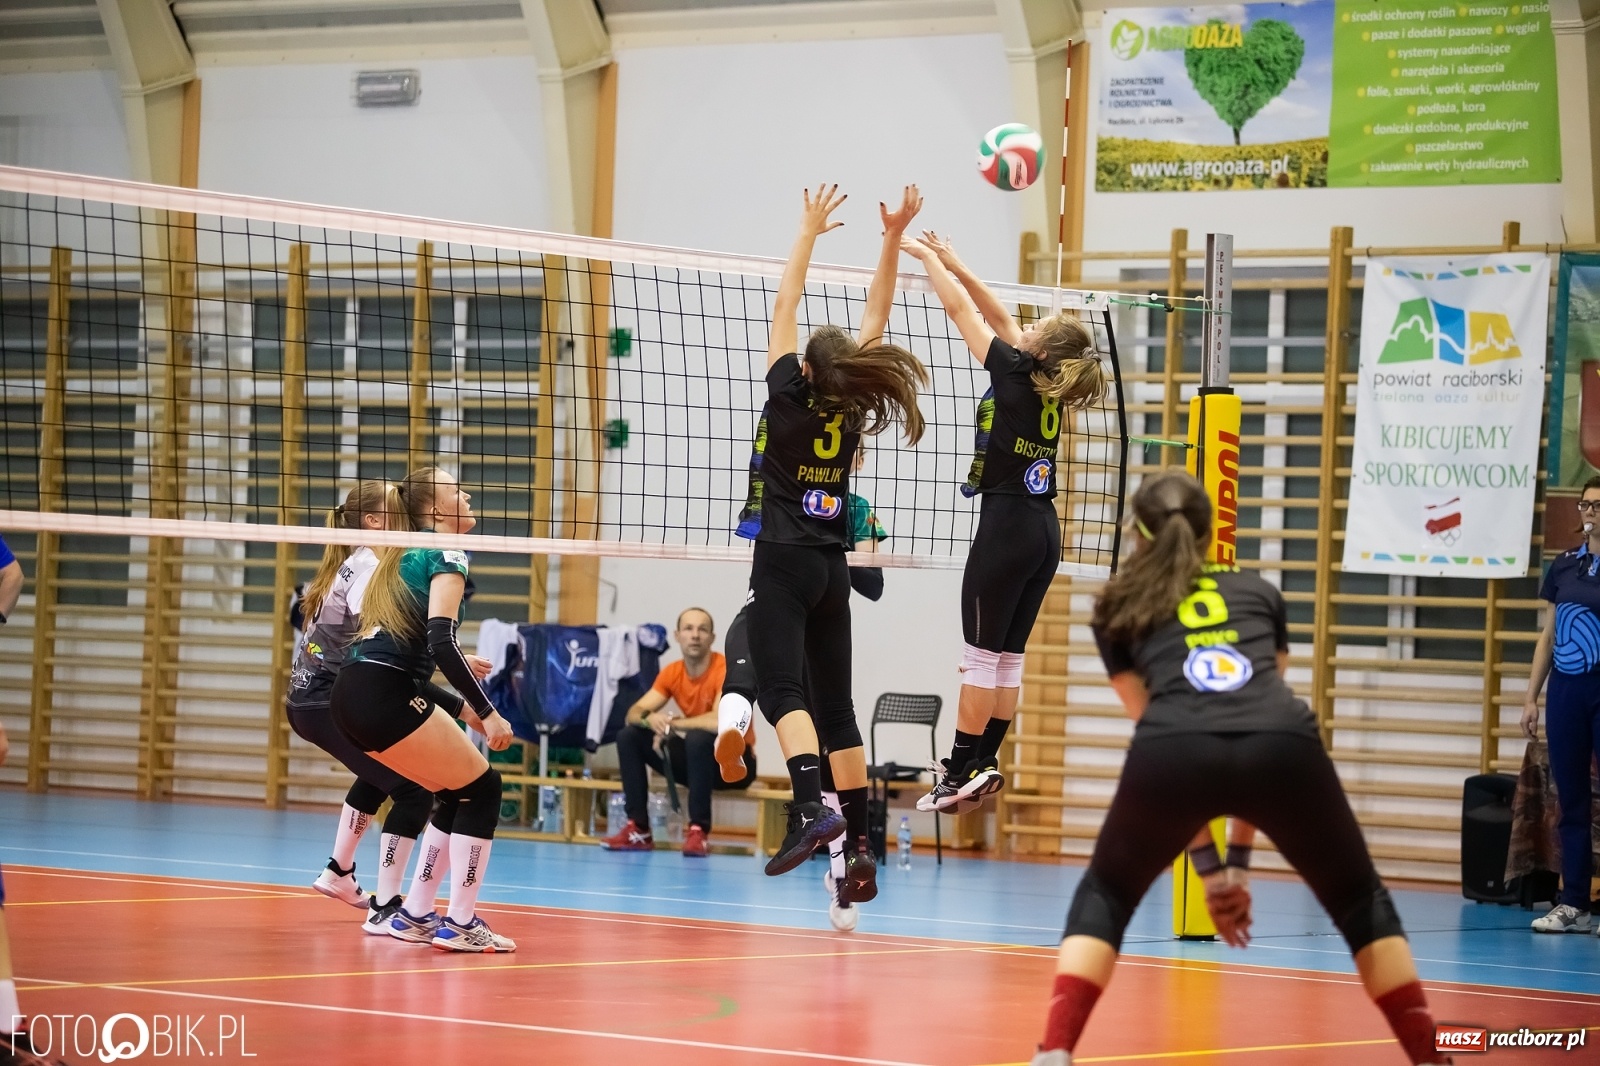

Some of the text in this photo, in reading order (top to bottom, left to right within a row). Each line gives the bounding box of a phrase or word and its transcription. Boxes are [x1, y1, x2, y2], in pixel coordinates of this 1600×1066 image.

[1351, 7, 1456, 22] środki ochrony roślin
[1469, 6, 1509, 18] nawozy
[1371, 30, 1400, 42] pasze
[1407, 26, 1447, 39] dodatki
[1449, 26, 1493, 39] paszowe
[1505, 21, 1540, 36] węgiel
[1397, 43, 1511, 60] systemy nawadniające
[1401, 65, 1449, 78] narzędzia
[1457, 62, 1505, 75] akcesoria
[1366, 80, 1540, 98] folie, sznurki, worki, agrowłókniny
[1462, 100, 1486, 113] kora
[1373, 119, 1529, 135] doniczki ozdobne, produkcyjne
[1415, 140, 1484, 154] pszczelarstwo
[1131, 154, 1290, 181] www.agrooaza.pl
[1370, 160, 1423, 173] zakuwanie
[1452, 156, 1529, 172] hydraulicznych
[1373, 369, 1523, 389] powiat raciborski
[1373, 390, 1425, 404] zielona
[813, 412, 845, 460] 3
[1379, 423, 1513, 456] KIBICUJEMY
[797, 464, 845, 483] PAWLIK
[1363, 460, 1530, 489] SPORTOWCOM
[409, 695, 428, 715] 15
